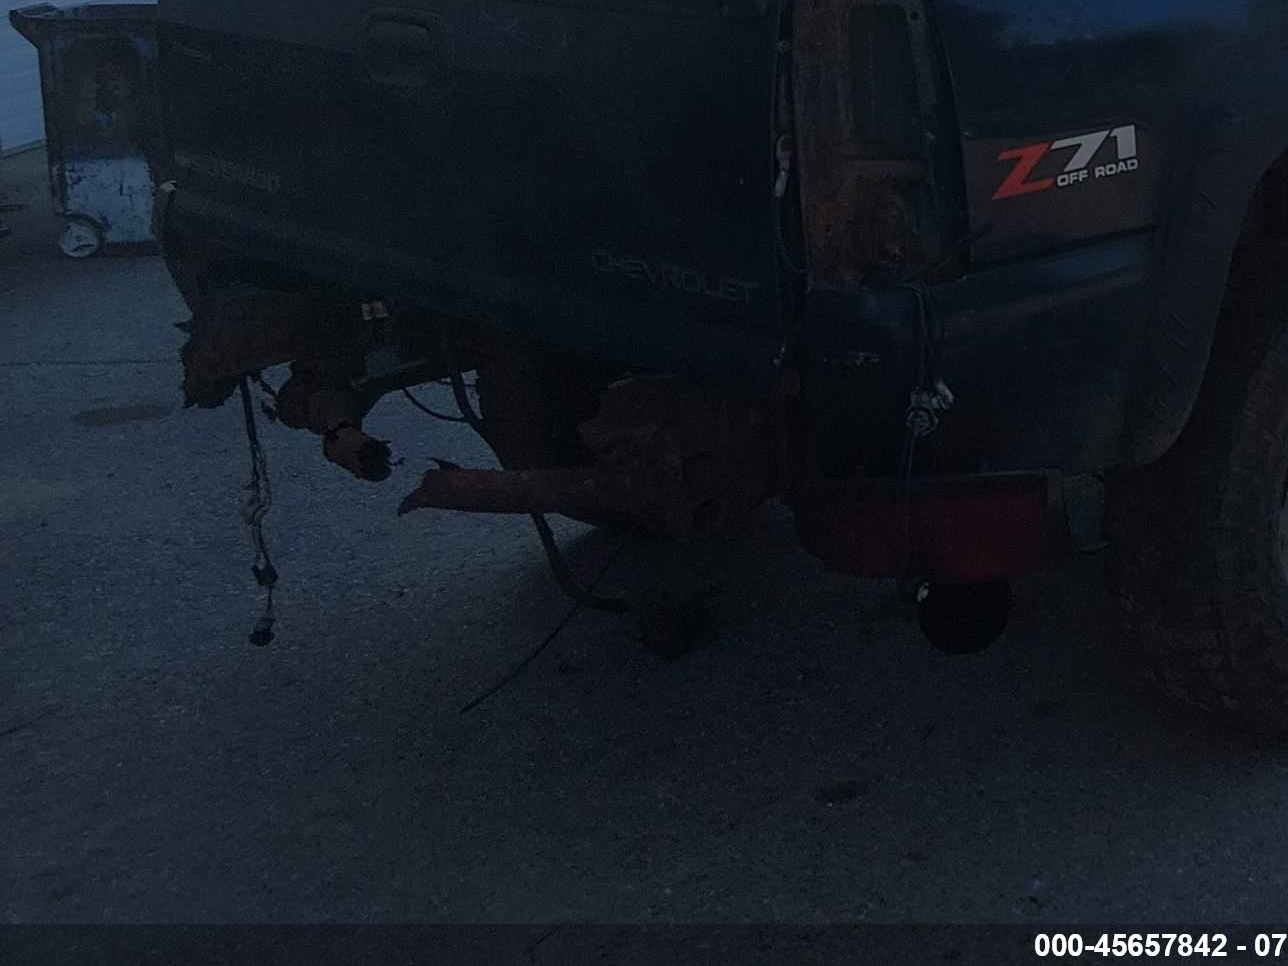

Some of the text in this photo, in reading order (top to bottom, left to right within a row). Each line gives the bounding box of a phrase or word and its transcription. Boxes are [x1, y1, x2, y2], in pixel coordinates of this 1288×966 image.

[992, 124, 1137, 202] Z71
[1057, 159, 1138, 187] OFF ROAD
[591, 247, 759, 304] CHEVROLET
